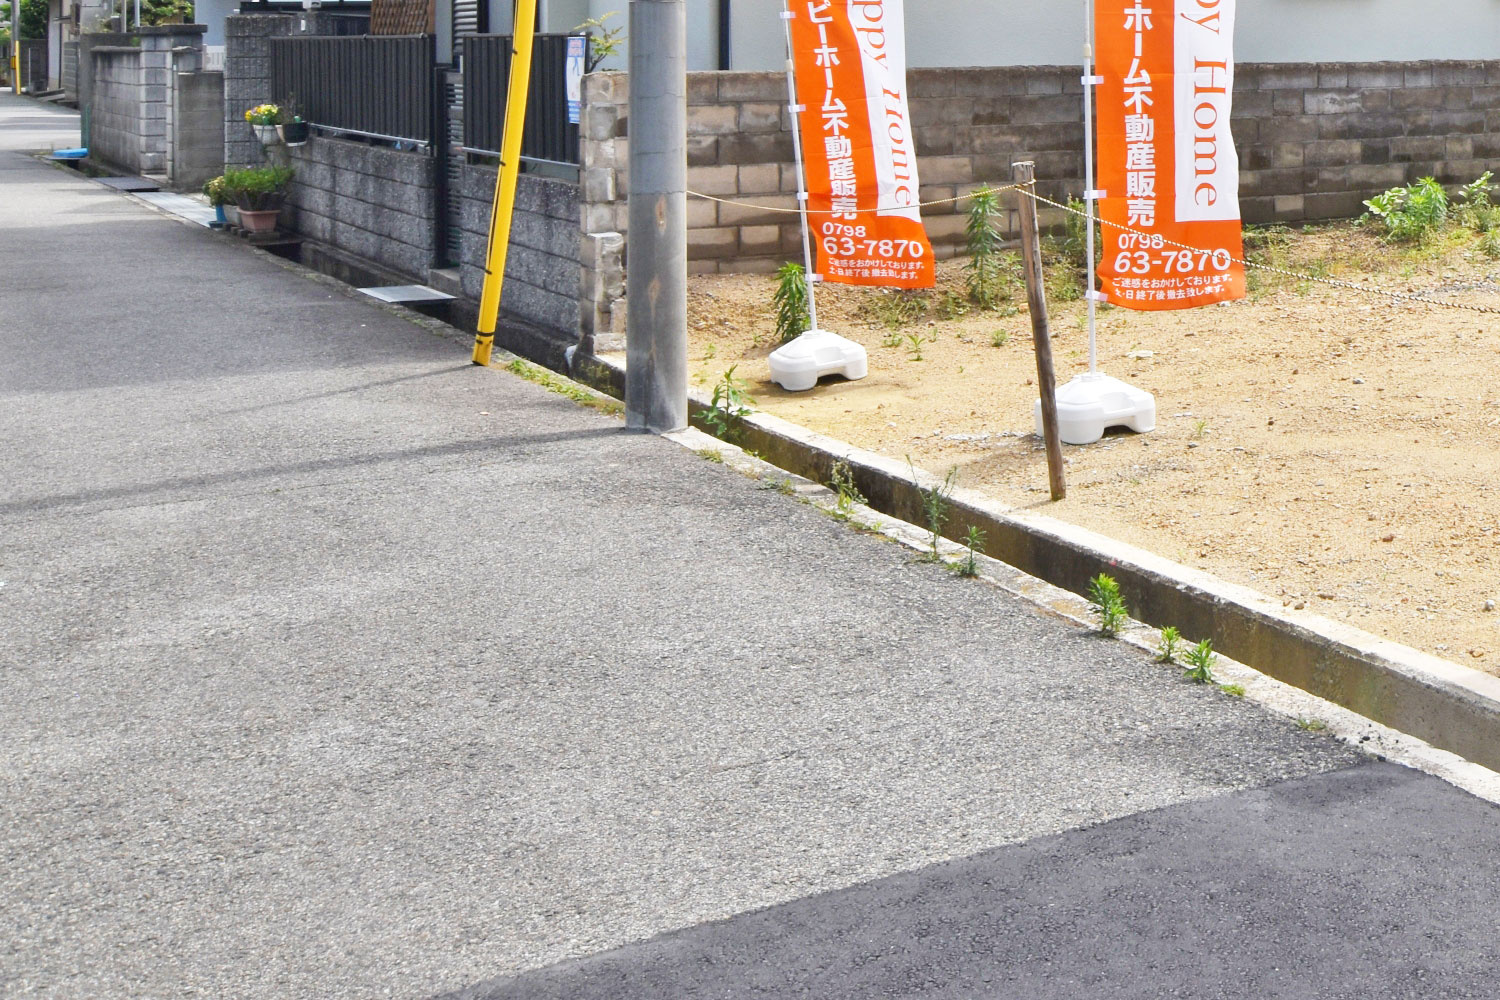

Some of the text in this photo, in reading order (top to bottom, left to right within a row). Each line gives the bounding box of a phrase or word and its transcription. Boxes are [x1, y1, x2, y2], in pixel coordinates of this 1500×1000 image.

[1193, 58, 1230, 207] Home
[822, 222, 866, 237] 0798
[823, 237, 924, 258] 63-7870
[1118, 233, 1164, 249] 0798
[1114, 248, 1231, 274] 63-7870
